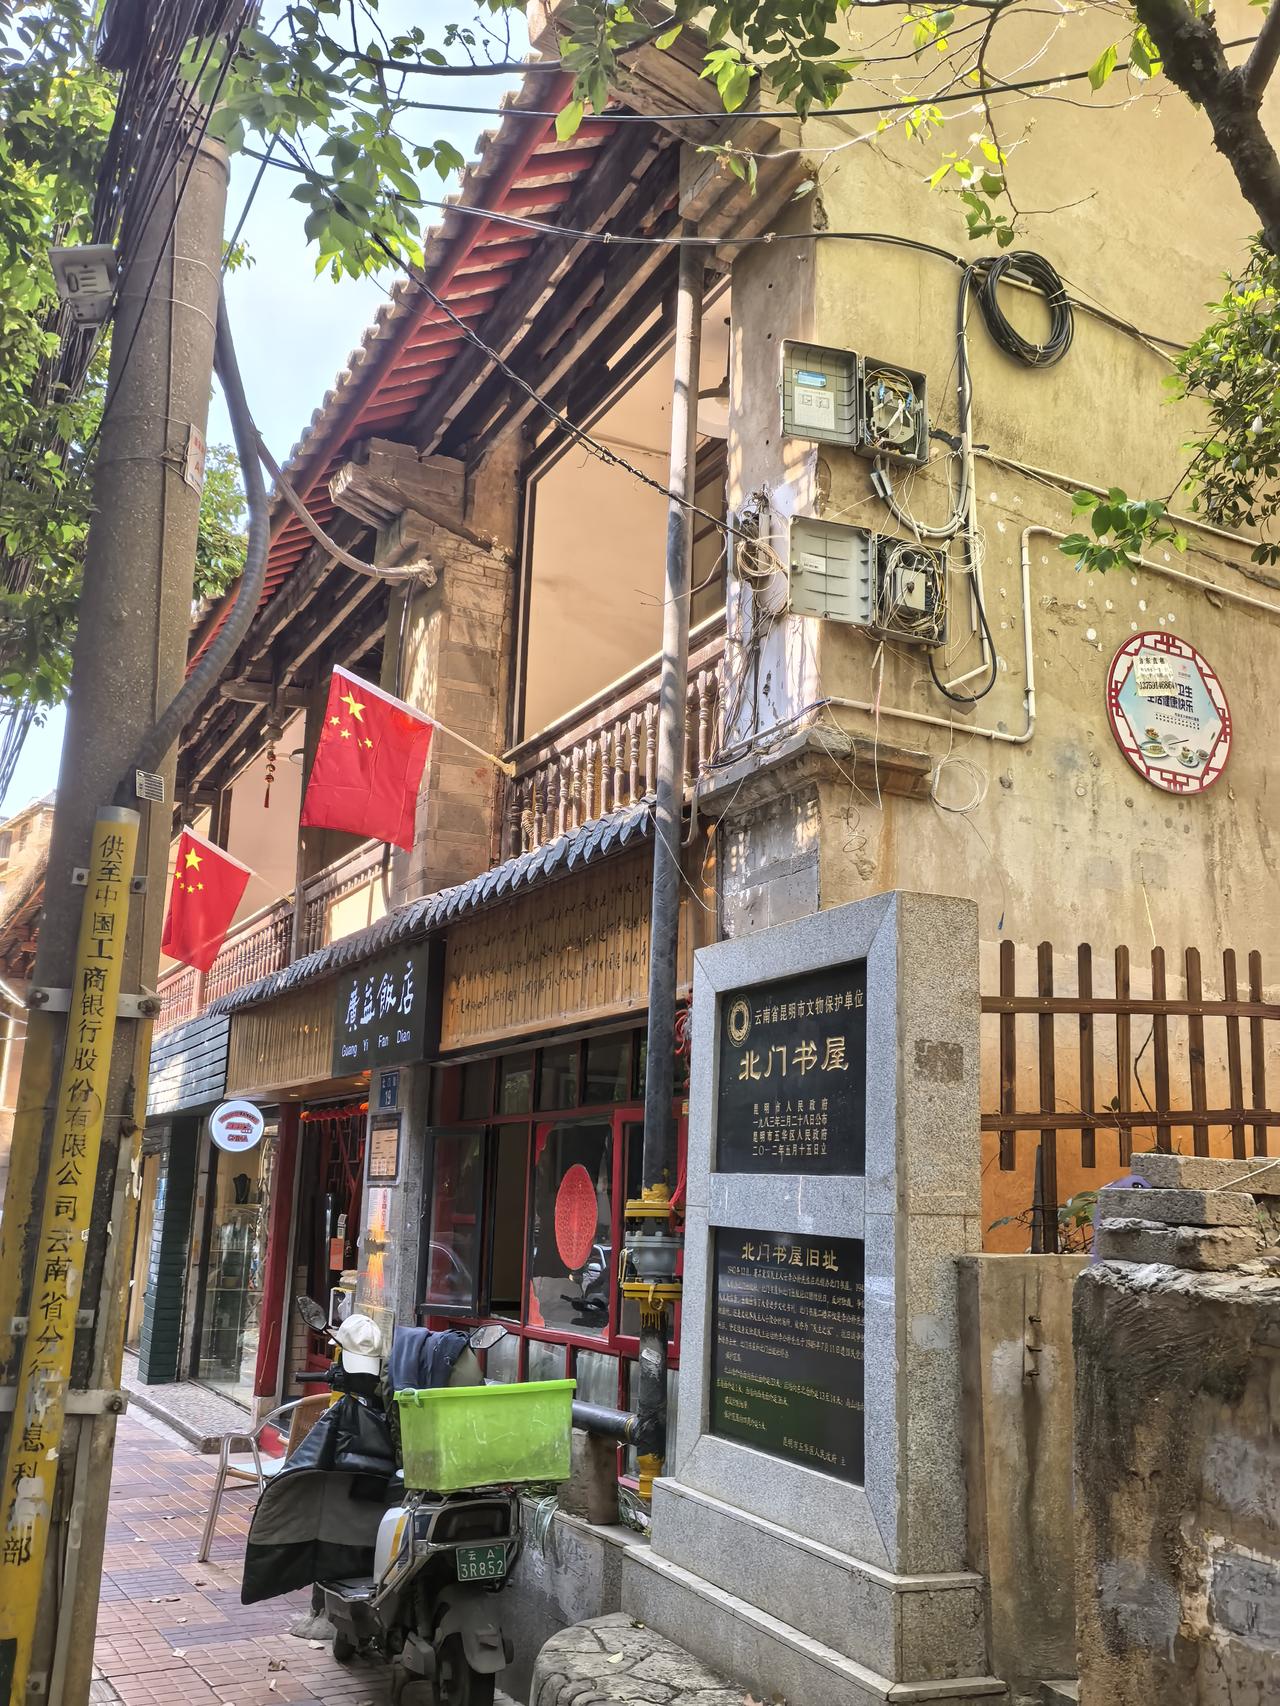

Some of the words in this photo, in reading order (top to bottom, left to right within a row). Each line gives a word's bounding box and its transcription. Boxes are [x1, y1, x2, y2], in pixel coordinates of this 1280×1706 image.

[754, 989, 864, 1026] 云南省昆明市文物保护单位
[342, 1044, 358, 1057] Guang
[363, 1038, 369, 1052] Yi
[378, 1035, 389, 1048] Fan
[396, 1029, 411, 1044] Dian
[738, 1035, 849, 1081] 北门书屋
[753, 1096, 828, 1115] 昆明市人民政府
[752, 1113, 828, 1128] 一九八三年三月二十八日公布
[753, 1128, 828, 1143] 昆明市五华区人民政府
[741, 1241, 840, 1272] 北门书屋旧址
[468, 1550, 476, 1561] 云
[487, 1549, 495, 1559] A
[461, 1560, 504, 1578] 3R852
